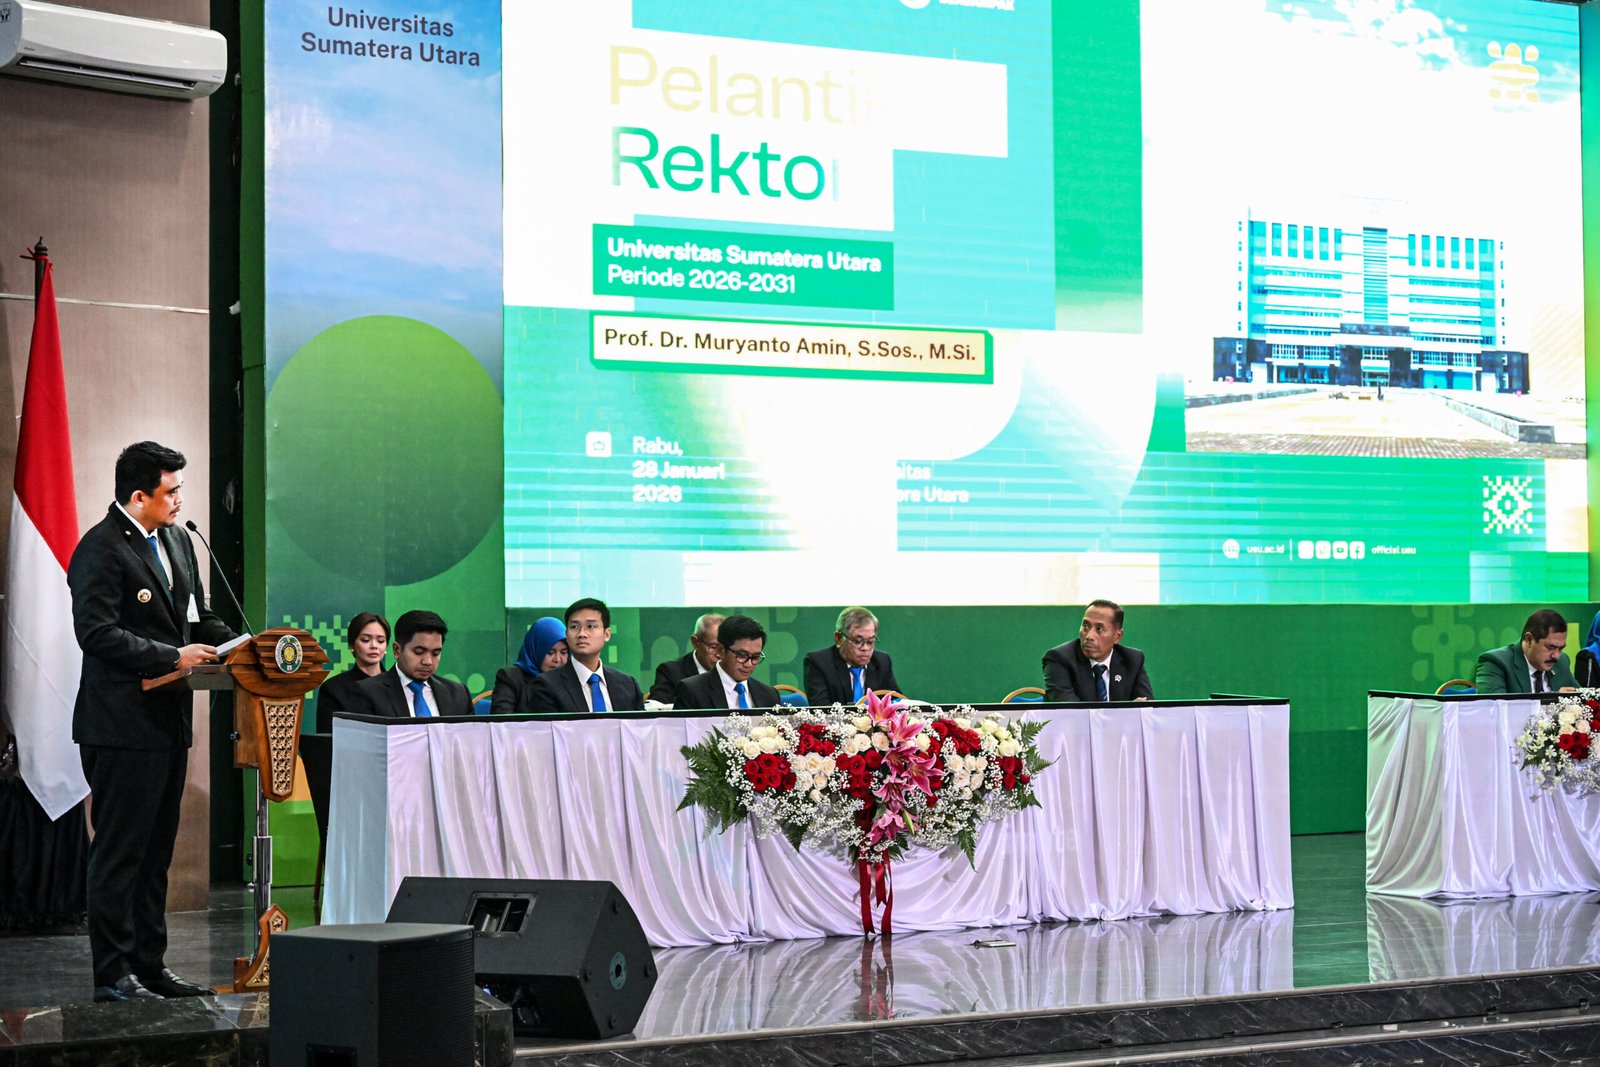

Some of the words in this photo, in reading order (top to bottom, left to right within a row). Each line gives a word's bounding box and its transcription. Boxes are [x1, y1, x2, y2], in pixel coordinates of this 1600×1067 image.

[328, 6, 454, 37] Universitas
[301, 32, 412, 60] Sumatera
[419, 42, 480, 67] Utara
[609, 45, 872, 125] Pelanti
[607, 237, 722, 263] Universitas
[726, 245, 823, 270] Sumatera
[827, 251, 882, 272] Utara
[608, 264, 685, 288] Periode
[688, 269, 796, 294] 2026-2031
[605, 328, 653, 346] Prof.
[660, 331, 688, 348] Dr.
[695, 333, 790, 354] Muryanto
[797, 338, 851, 358] Amin,
[858, 340, 923, 360] S.Sos.,
[929, 343, 976, 361] M.Si.
[632, 436, 683, 456] Rabu,
[632, 460, 658, 478] 28
[661, 461, 725, 480] Januari
[632, 484, 683, 502] 2026
[924, 485, 969, 502] Utara
